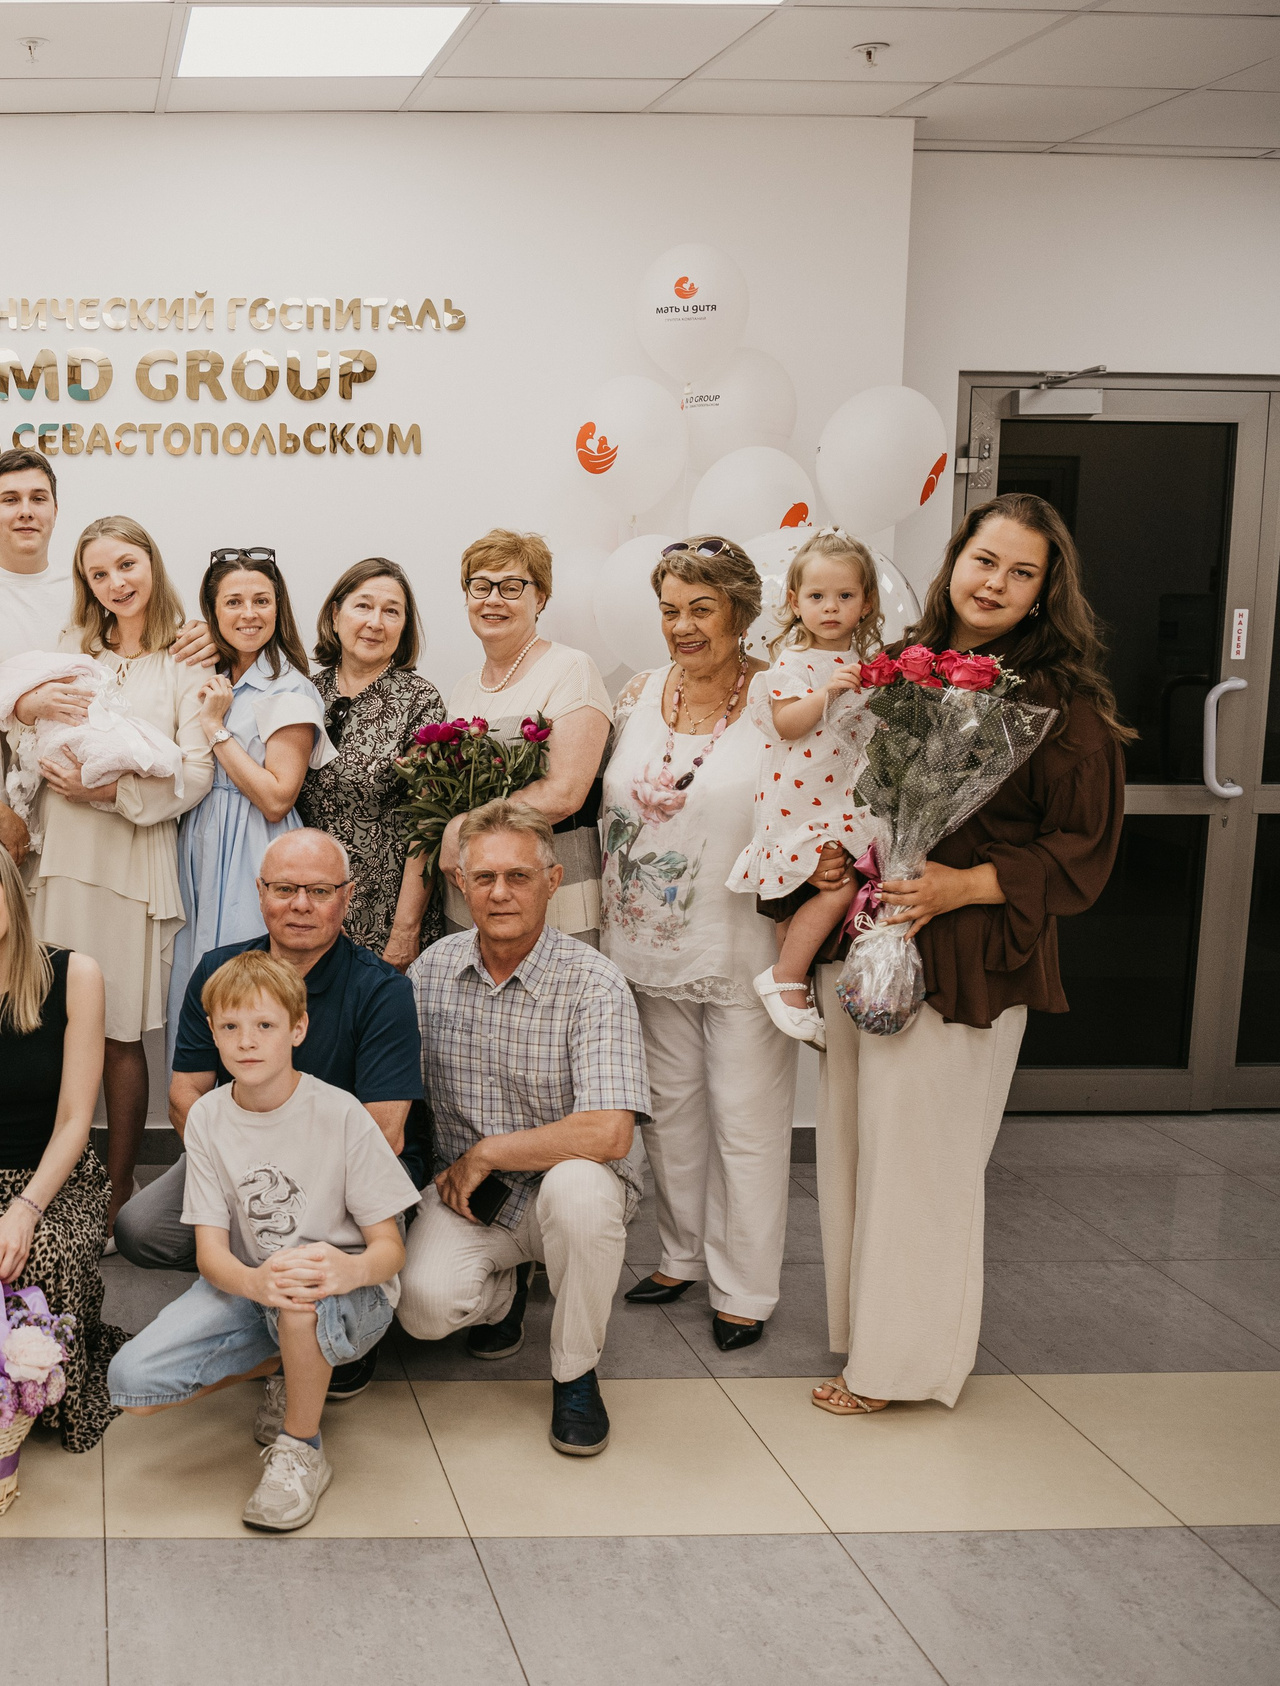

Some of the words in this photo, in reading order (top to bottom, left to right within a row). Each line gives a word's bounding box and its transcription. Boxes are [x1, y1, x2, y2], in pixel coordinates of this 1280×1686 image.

[227, 297, 467, 331] ГОСПИТАЛЬ
[656, 306, 680, 314] мать
[691, 304, 717, 314] дитя
[135, 348, 378, 402] GROUP
[695, 394, 720, 403] GROUP
[12, 422, 422, 456] СЕВАСТОПОЛЬСКОМ
